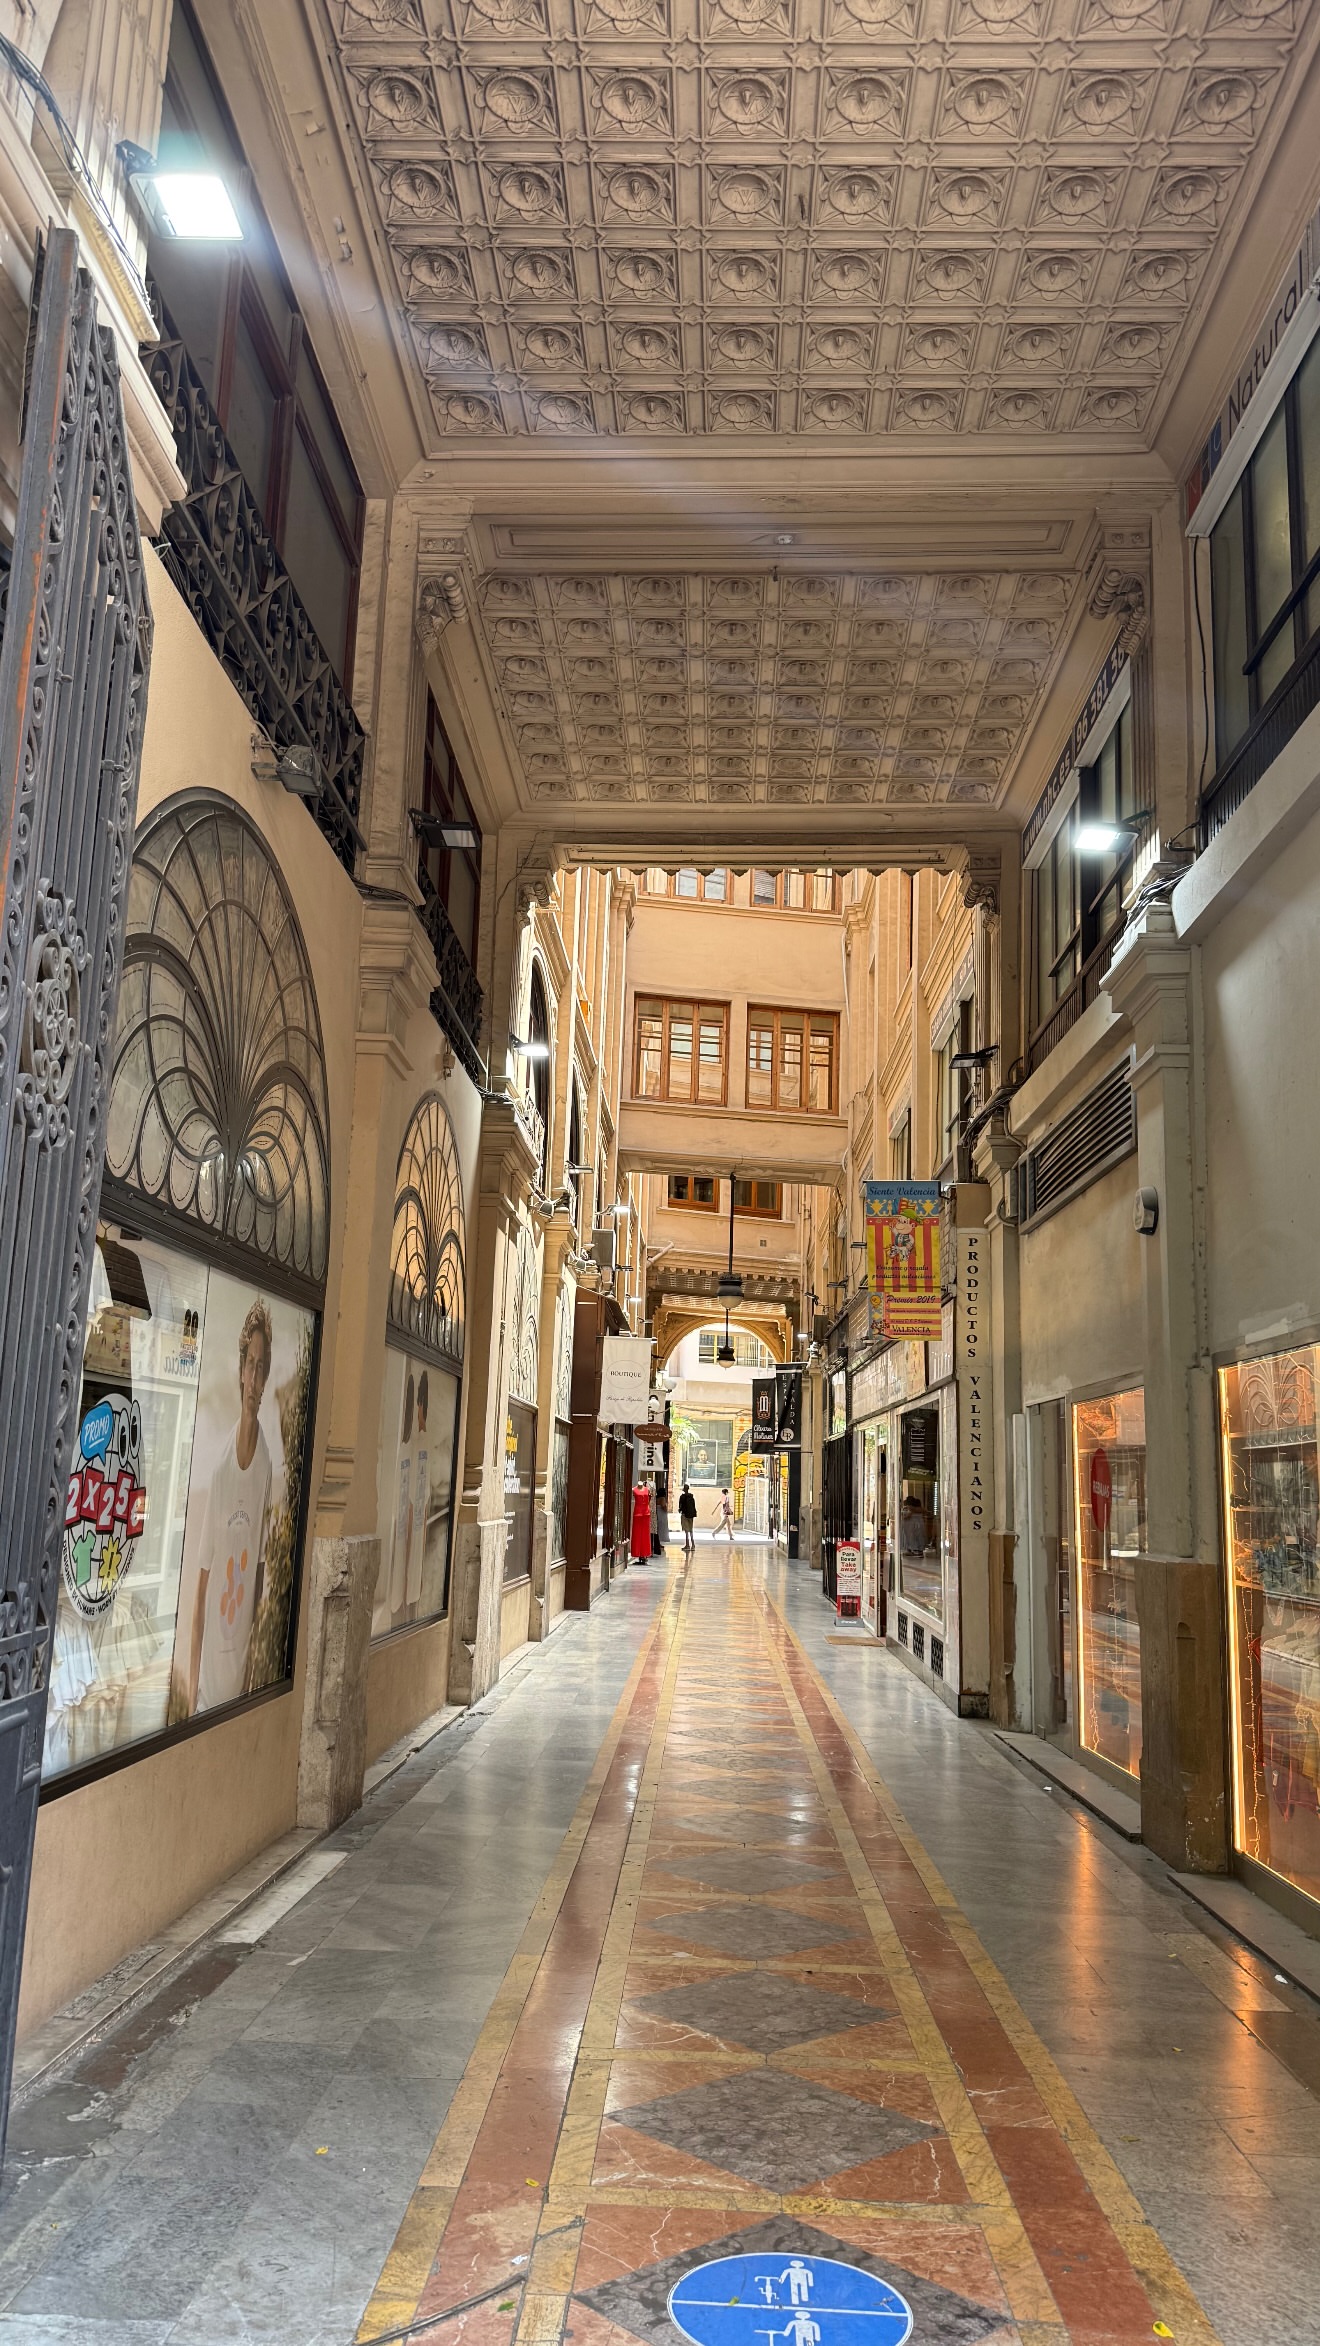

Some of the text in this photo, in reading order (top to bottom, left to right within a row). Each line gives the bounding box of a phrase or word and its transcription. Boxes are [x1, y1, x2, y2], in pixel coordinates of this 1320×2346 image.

[1024, 751, 1071, 856] www.nhc.es
[1075, 712, 1088, 747] 96
[1090, 669, 1109, 721] 381
[868, 1186, 936, 1196] Siente Valencia
[916, 1295, 937, 1304] 2019
[966, 1237, 983, 1531] PRODUCTOS VALENCIANOS
[83, 1414, 109, 1445] PROMO
